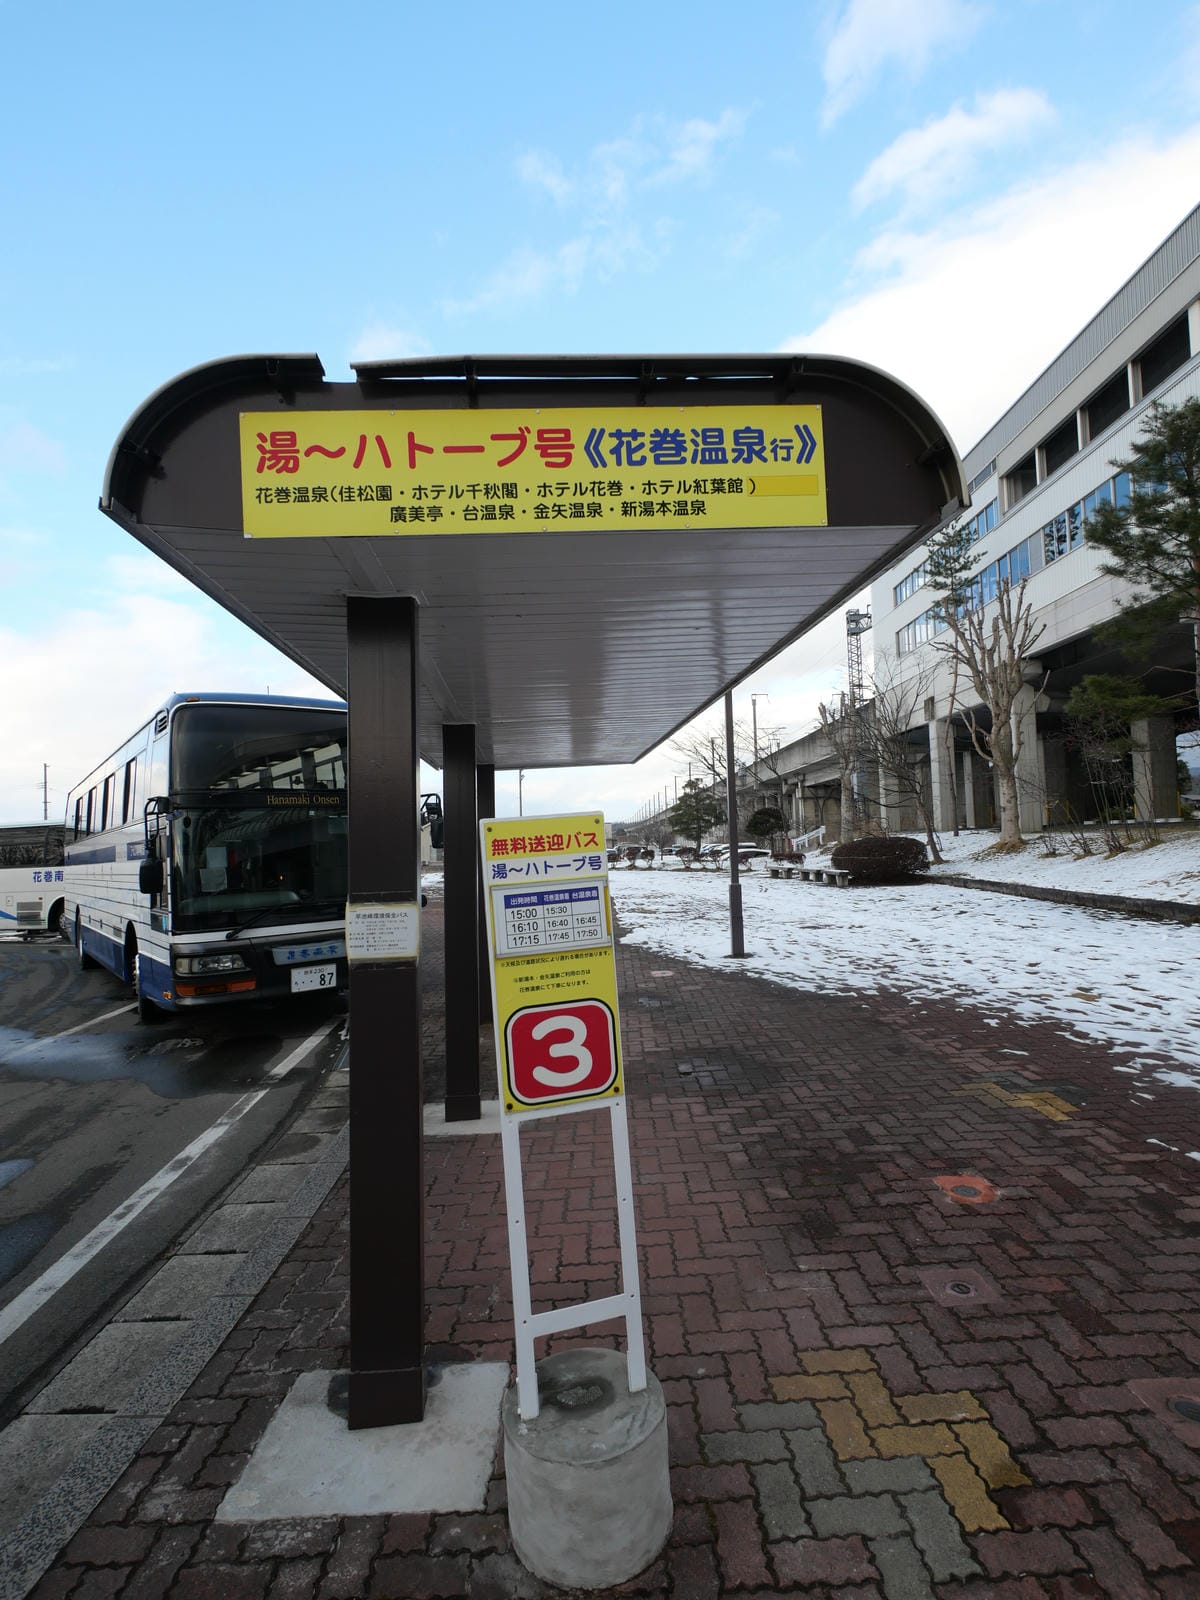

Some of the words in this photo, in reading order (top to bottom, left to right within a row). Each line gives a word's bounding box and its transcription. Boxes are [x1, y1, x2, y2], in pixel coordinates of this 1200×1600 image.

[267, 794, 310, 805] Hanamaki
[313, 795, 340, 805] Onsen
[491, 831, 599, 856] 無料送迎バス
[33, 870, 64, 883] 花巻南
[510, 908, 538, 920] 15:00
[546, 906, 568, 915] 15:30
[512, 921, 539, 933] 16:10
[547, 919, 569, 928] 16:40
[576, 916, 597, 925] 16:45
[513, 934, 540, 946] 17:15
[548, 932, 570, 941] 17:45
[577, 929, 598, 938] 17:50
[531, 1015, 593, 1087] 3
